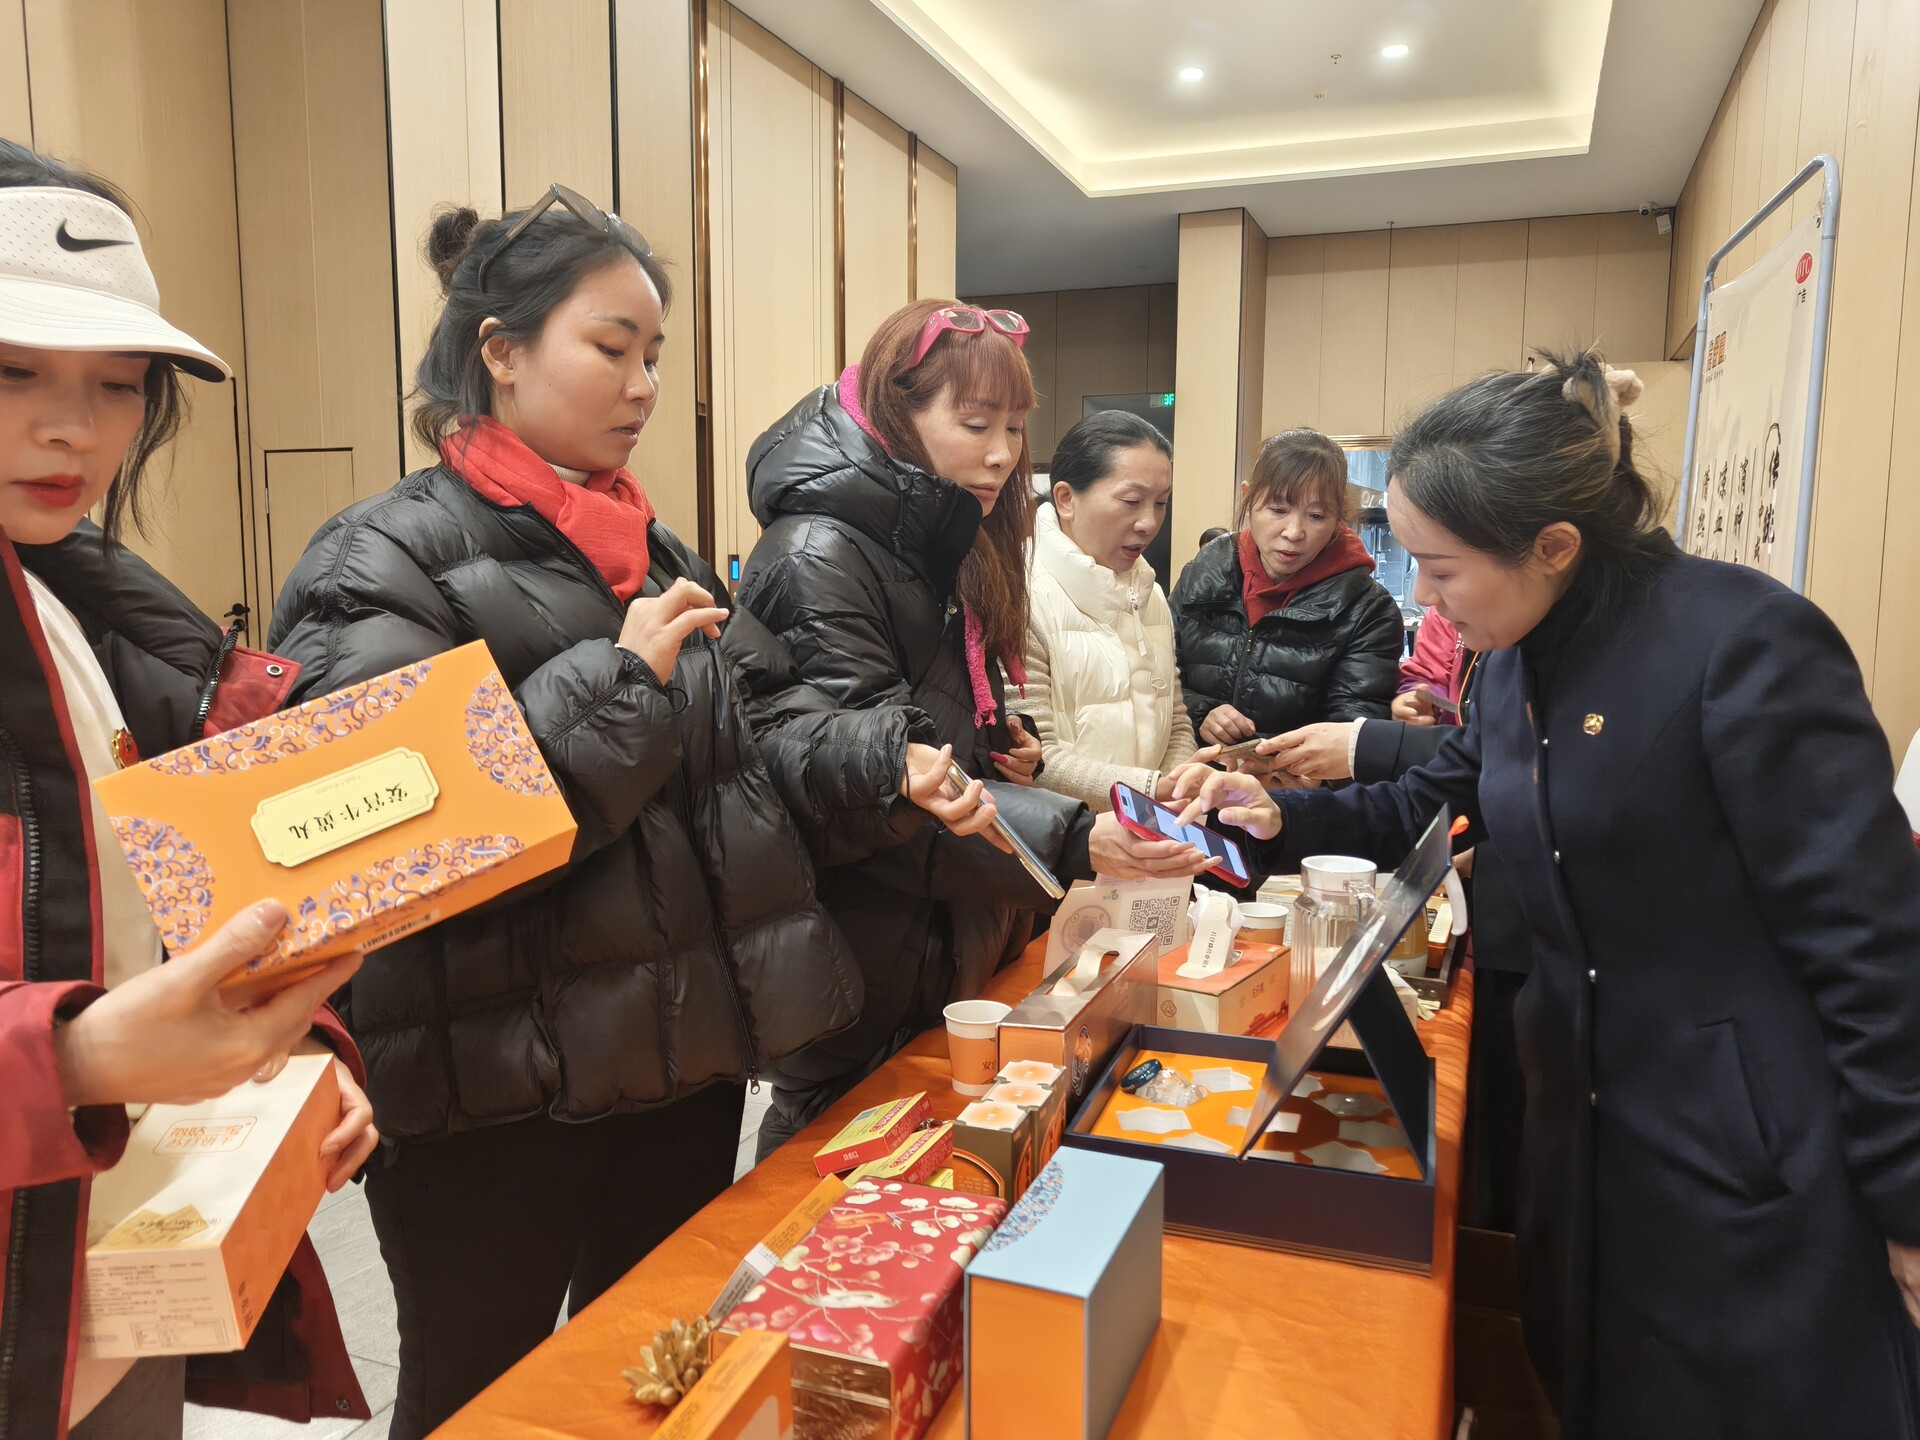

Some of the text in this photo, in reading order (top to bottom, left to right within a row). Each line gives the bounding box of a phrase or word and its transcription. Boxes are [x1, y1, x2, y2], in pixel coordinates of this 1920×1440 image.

[1796, 256, 1811, 280] OTC
[1796, 288, 1807, 308] 广告
[288, 782, 408, 840] 安宫牛黄丸
